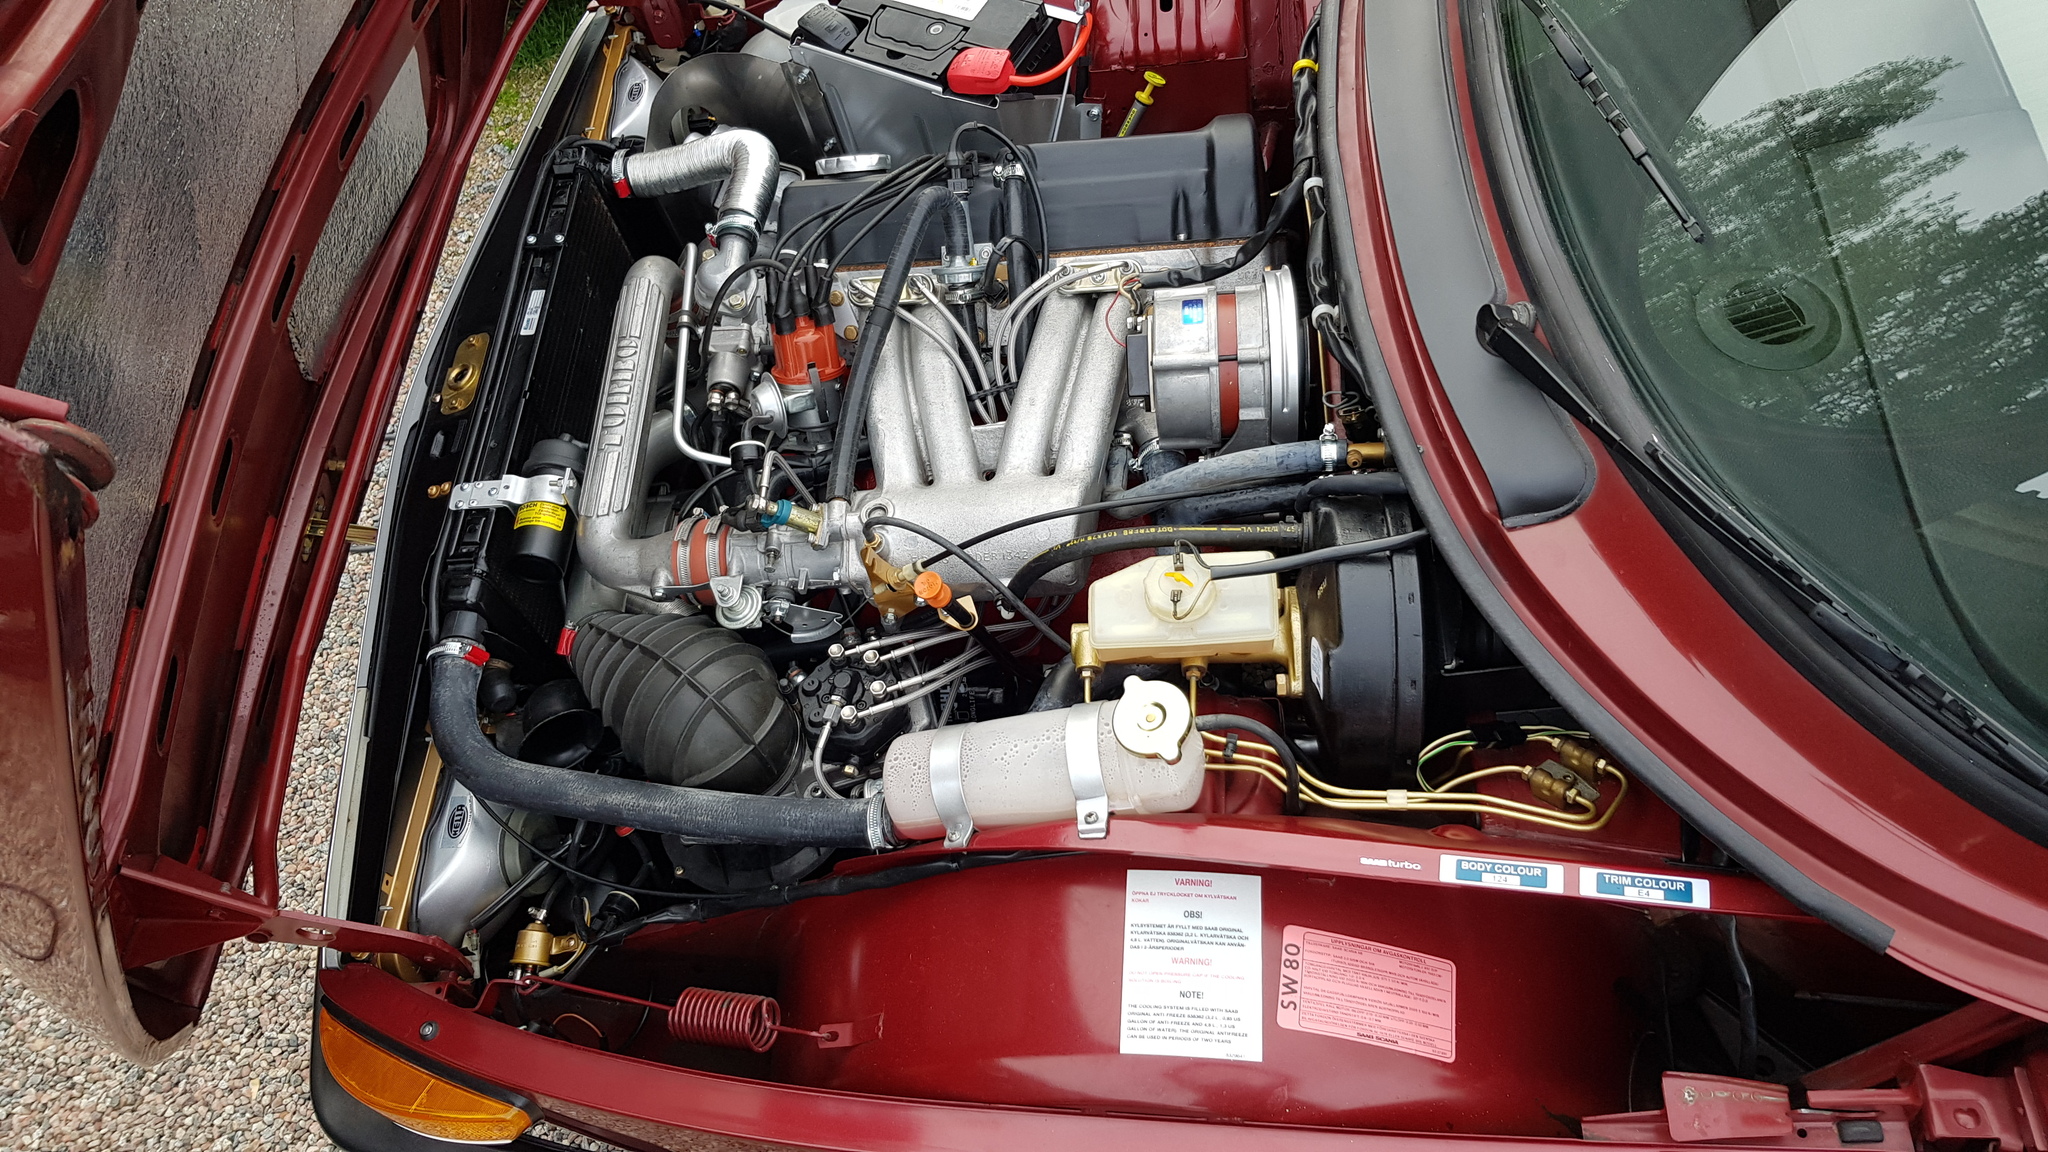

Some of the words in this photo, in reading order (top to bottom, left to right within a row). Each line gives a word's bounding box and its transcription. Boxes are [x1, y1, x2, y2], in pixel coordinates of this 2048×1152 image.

[599, 334, 640, 451] TURBO
[452, 804, 465, 836] HELLA
[1461, 861, 1492, 873] BODY
[1494, 864, 1542, 877] COLOUR
[1174, 877, 1213, 888] VARNING!
[1492, 874, 1508, 884] 124
[1603, 874, 1632, 886] TRIM
[1634, 878, 1685, 892] COLOUR
[1204, 893, 1237, 901] KYLVÄTSKAN
[1638, 889, 1650, 897] E4
[1183, 910, 1203, 919] OBS!
[1171, 957, 1212, 966] WARNING!
[1179, 990, 1204, 999] NOTE!
